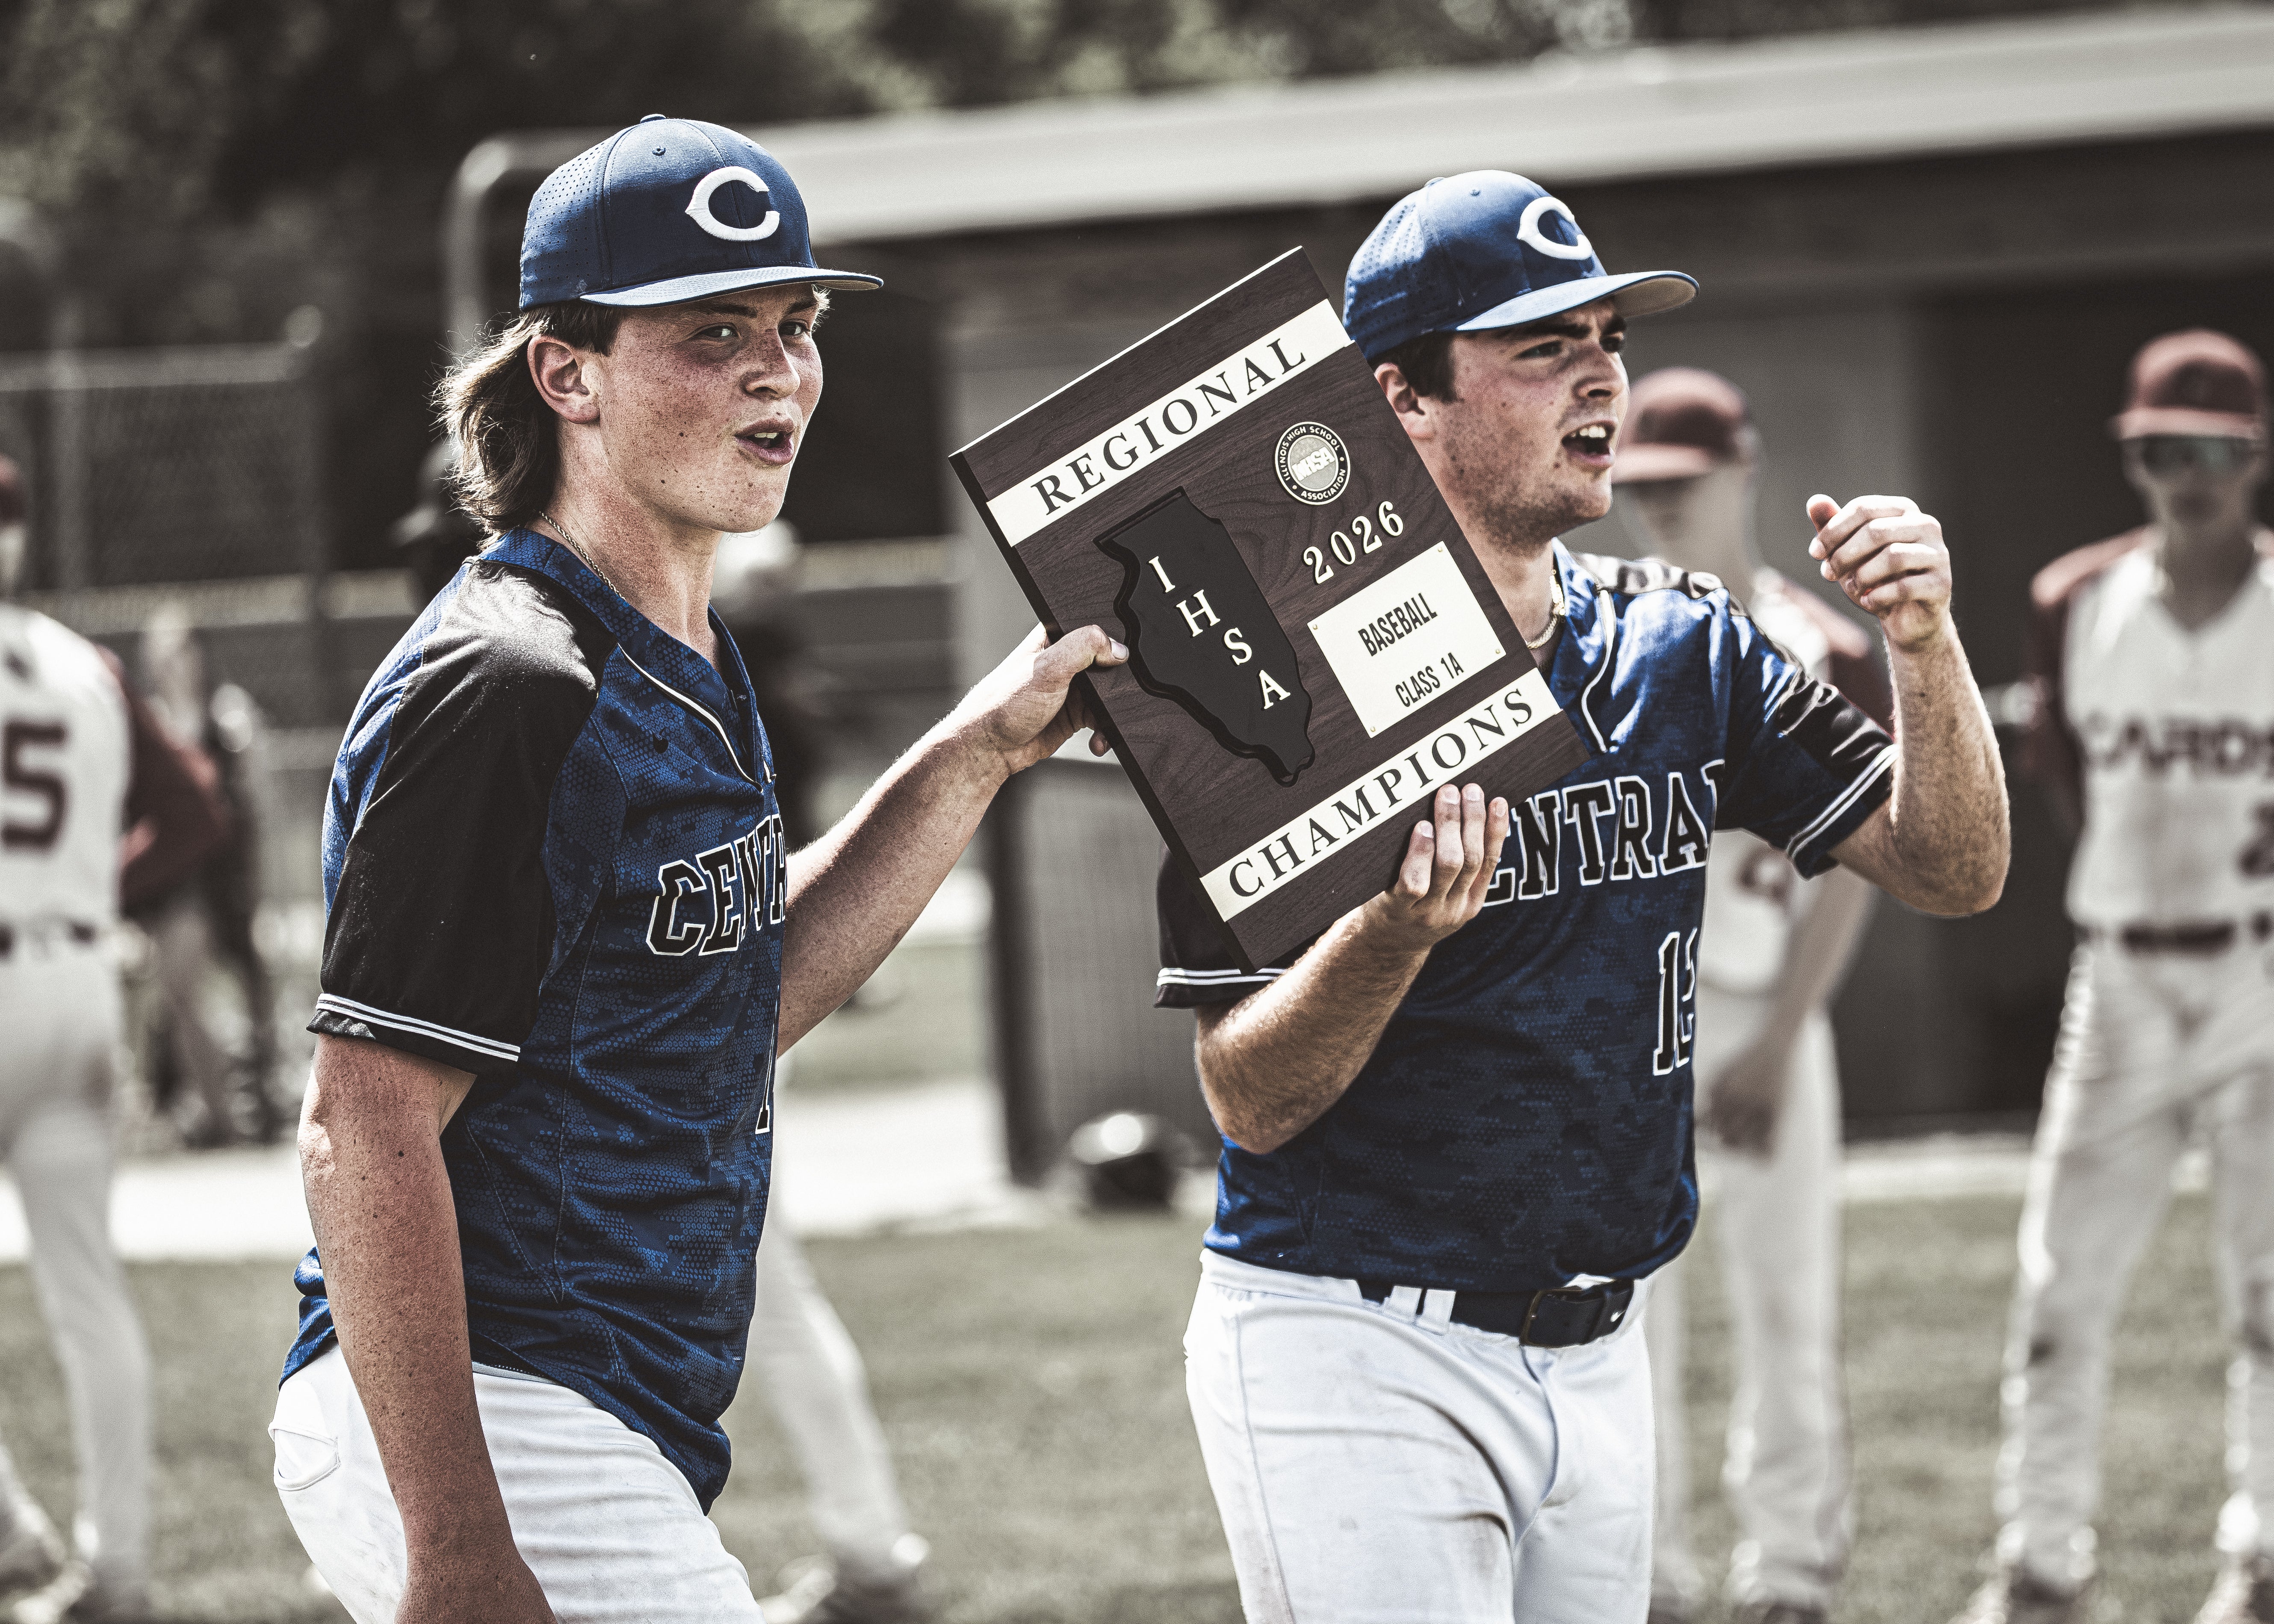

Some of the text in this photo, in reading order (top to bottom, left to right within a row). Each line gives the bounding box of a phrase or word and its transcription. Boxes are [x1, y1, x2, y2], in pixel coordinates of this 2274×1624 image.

[685, 165, 780, 242] C
[1517, 196, 1593, 260] C
[1030, 338, 1306, 516] REGIONAL
[1280, 426, 1341, 481] ILLINOIS HIGH SCHOOL
[1301, 468, 1346, 500] ASSOCIATION
[1303, 501, 1405, 584] 2026
[1358, 592, 1438, 657] BASEBALL
[1395, 652, 1464, 707] CLASS 1A
[1229, 689, 1533, 898] CHAMPIONS
